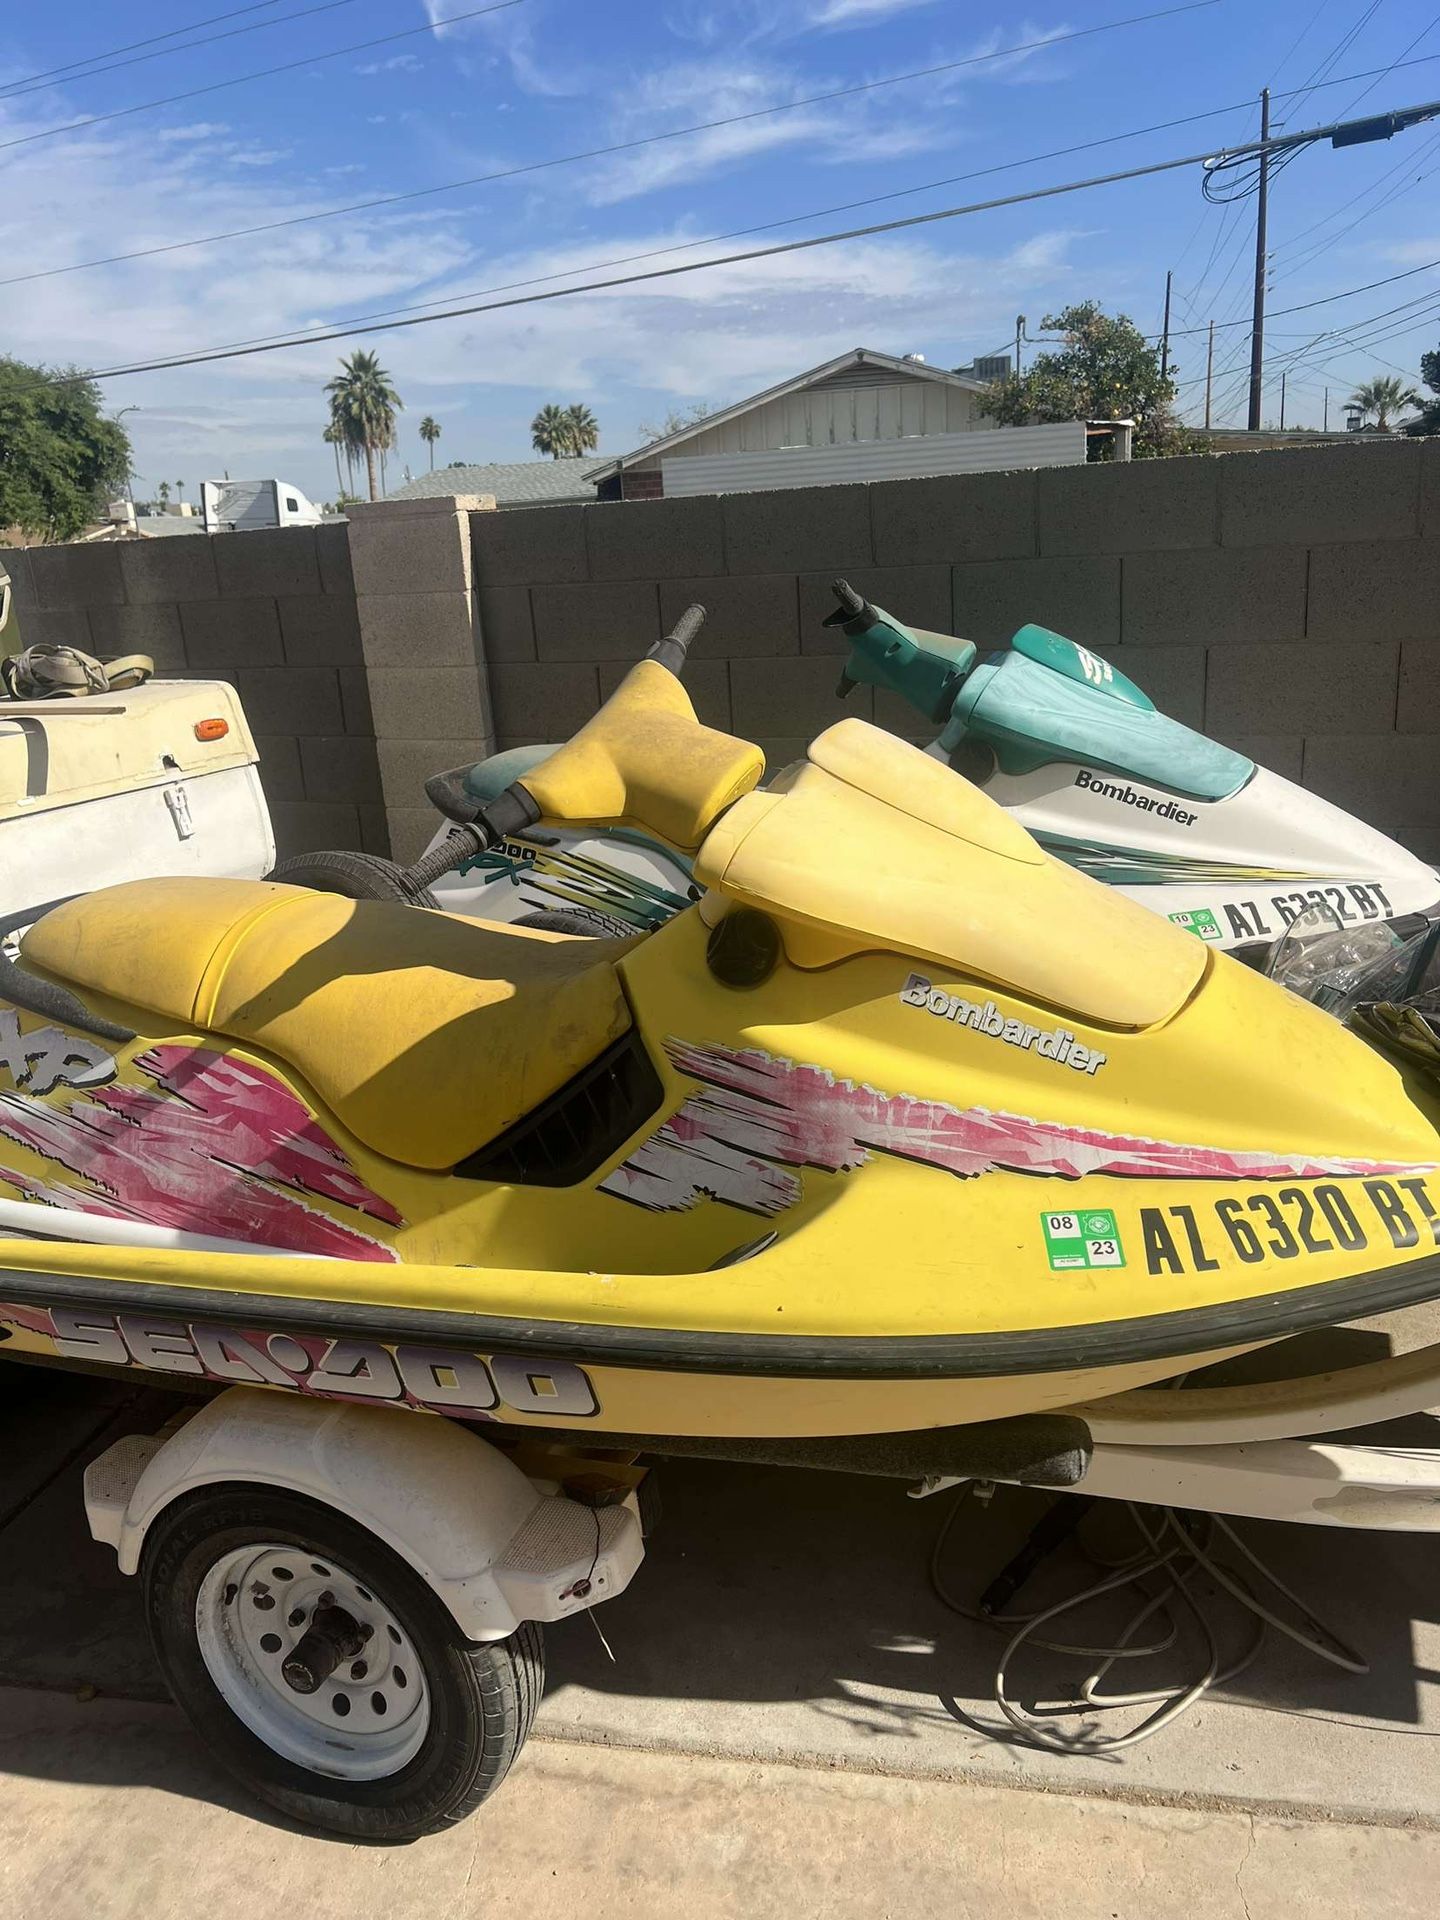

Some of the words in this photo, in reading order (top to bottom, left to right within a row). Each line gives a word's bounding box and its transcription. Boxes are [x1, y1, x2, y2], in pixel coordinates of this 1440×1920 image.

[1074, 769, 1198, 827] Bombardier
[1175, 914, 1189, 923] 10
[1201, 924, 1216, 933] 23
[1223, 902, 1271, 939] AZ
[1346, 883, 1394, 919] BT
[900, 971, 1108, 1075] Bombardier
[1050, 1216, 1073, 1230] 08
[1140, 1205, 1220, 1275] AZ
[1214, 1184, 1368, 1263] 6320
[1363, 1178, 1440, 1248] BT
[1092, 1241, 1115, 1255] 23
